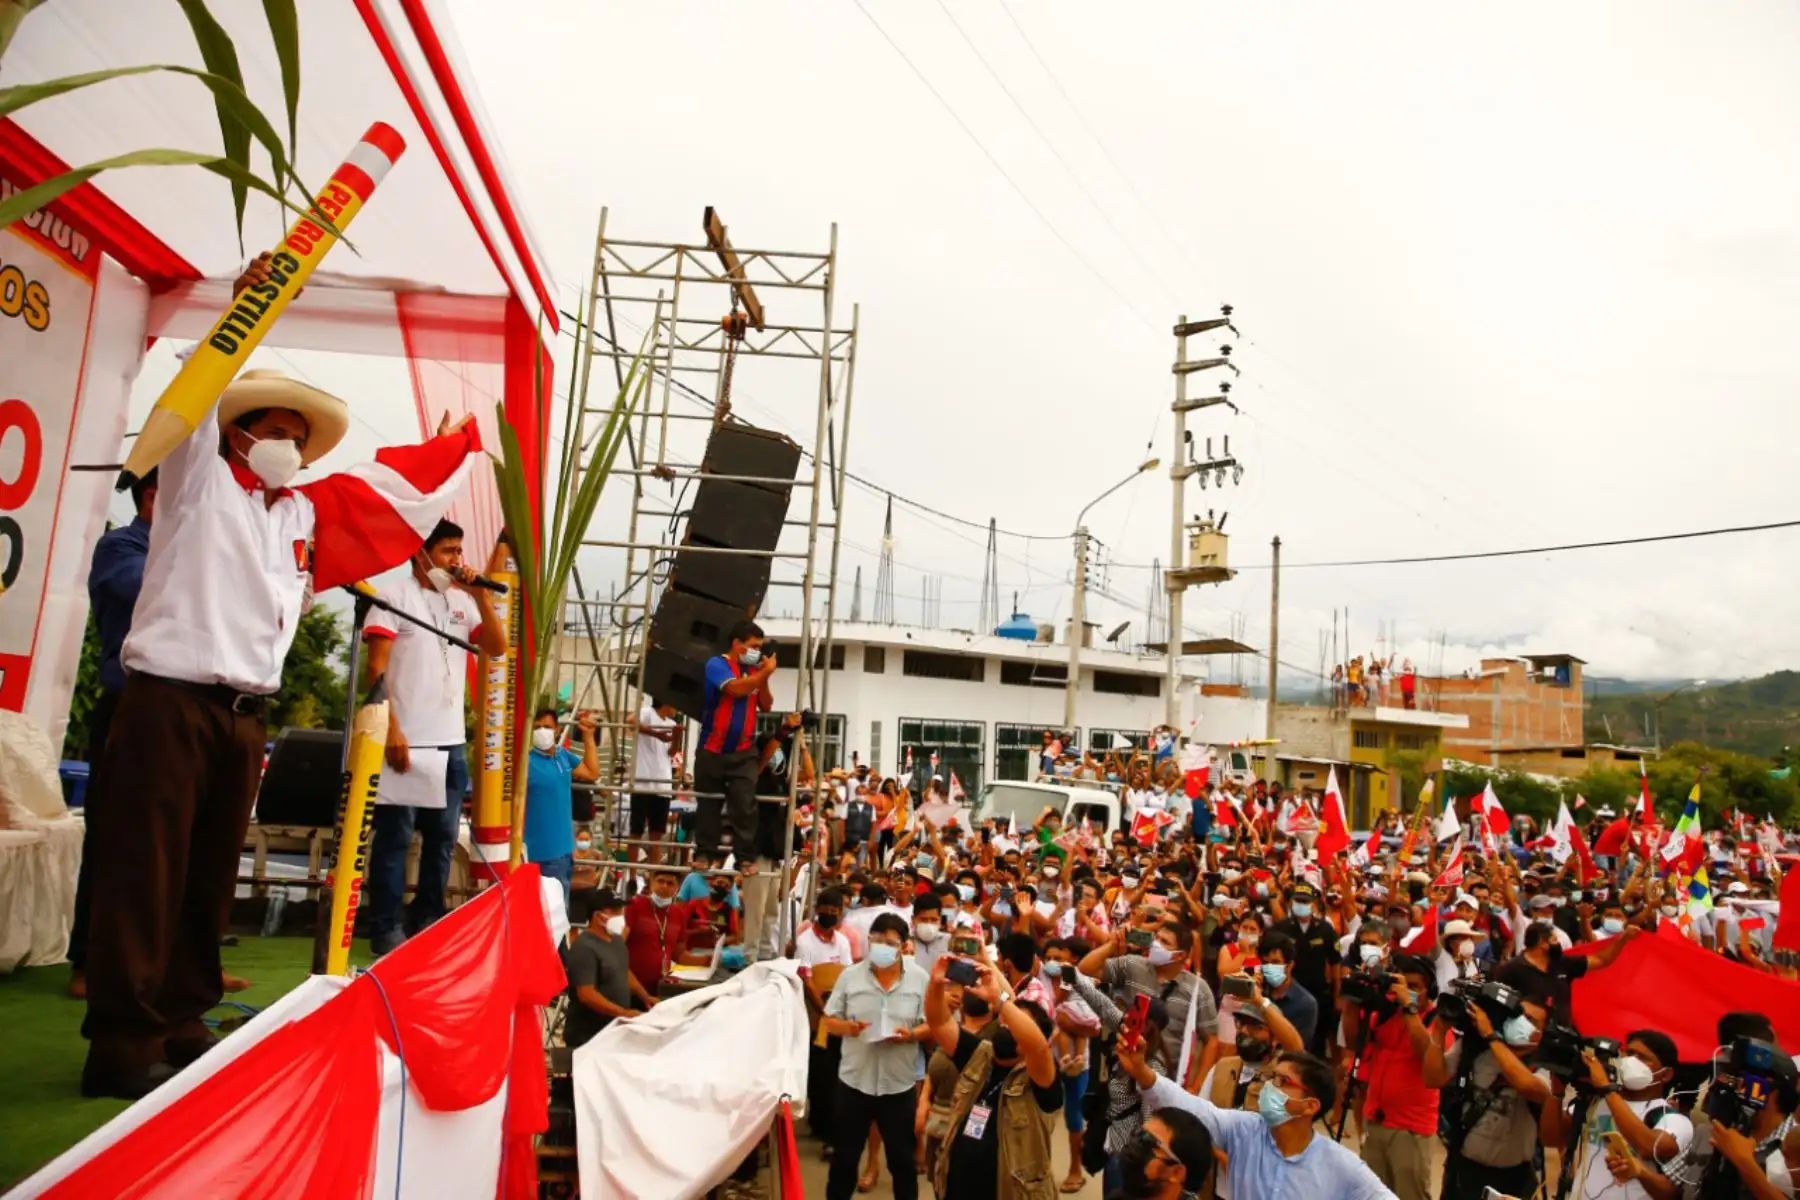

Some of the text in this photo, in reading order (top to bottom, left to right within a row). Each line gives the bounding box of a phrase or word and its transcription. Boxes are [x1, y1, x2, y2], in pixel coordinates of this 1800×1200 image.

[0, 263, 51, 332] OS
[209, 252, 300, 356] CASTILLO
[354, 773, 381, 872] CASTILLO
